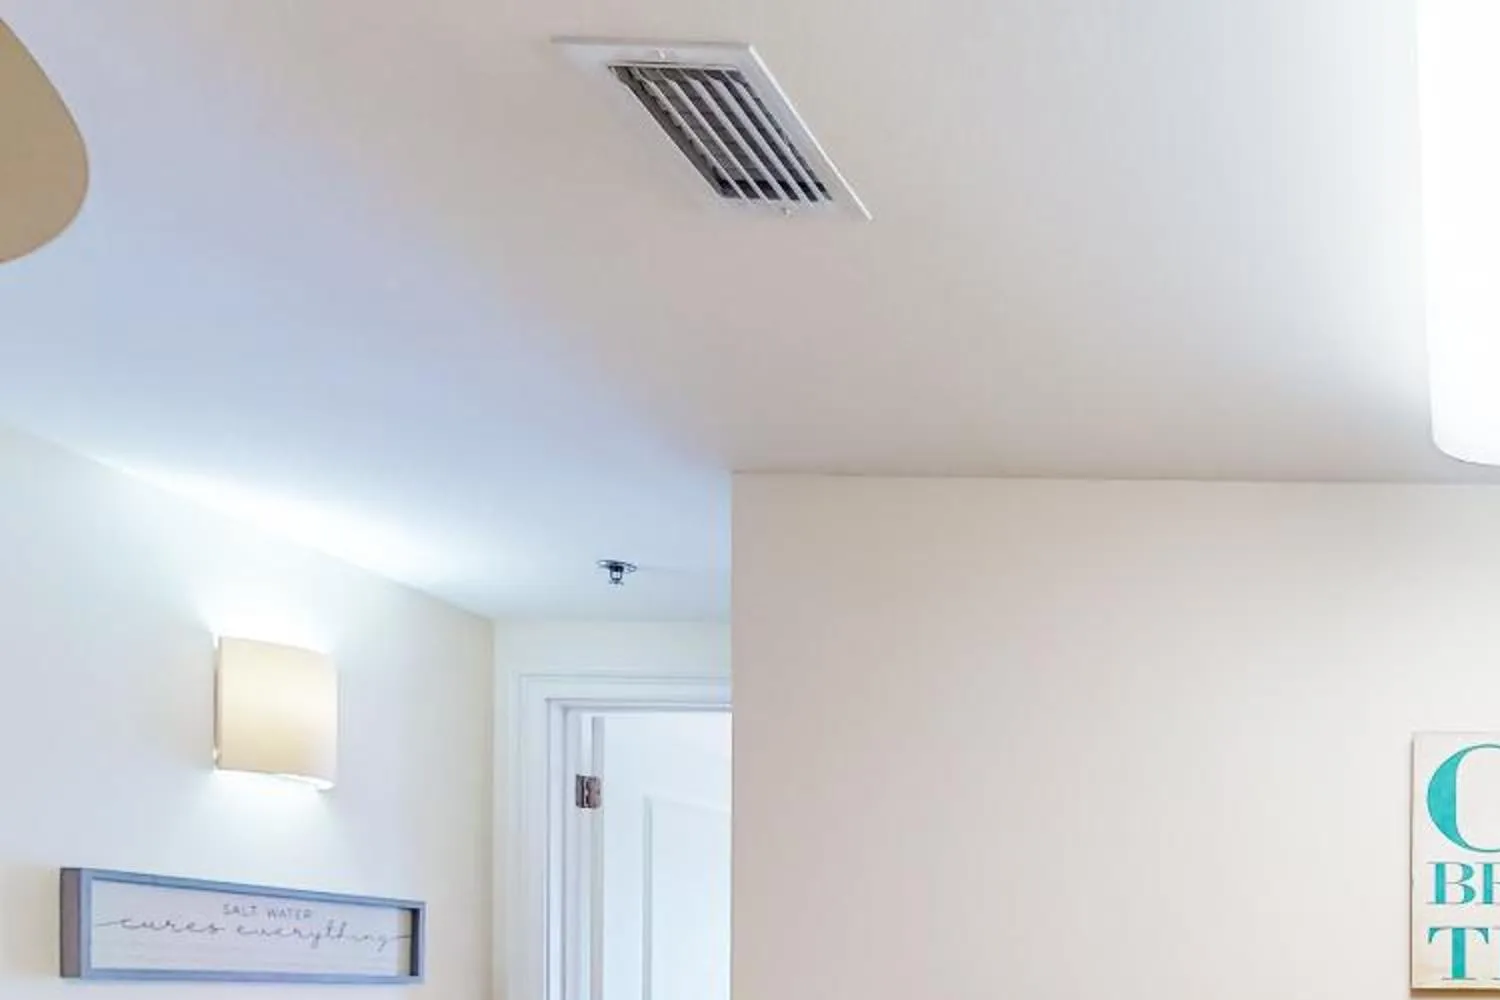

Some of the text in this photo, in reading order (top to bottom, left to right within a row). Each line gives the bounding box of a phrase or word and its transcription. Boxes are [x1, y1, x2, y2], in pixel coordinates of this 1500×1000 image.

[222, 903, 314, 921] SALT WATER
[98, 917, 411, 951] cures everything
